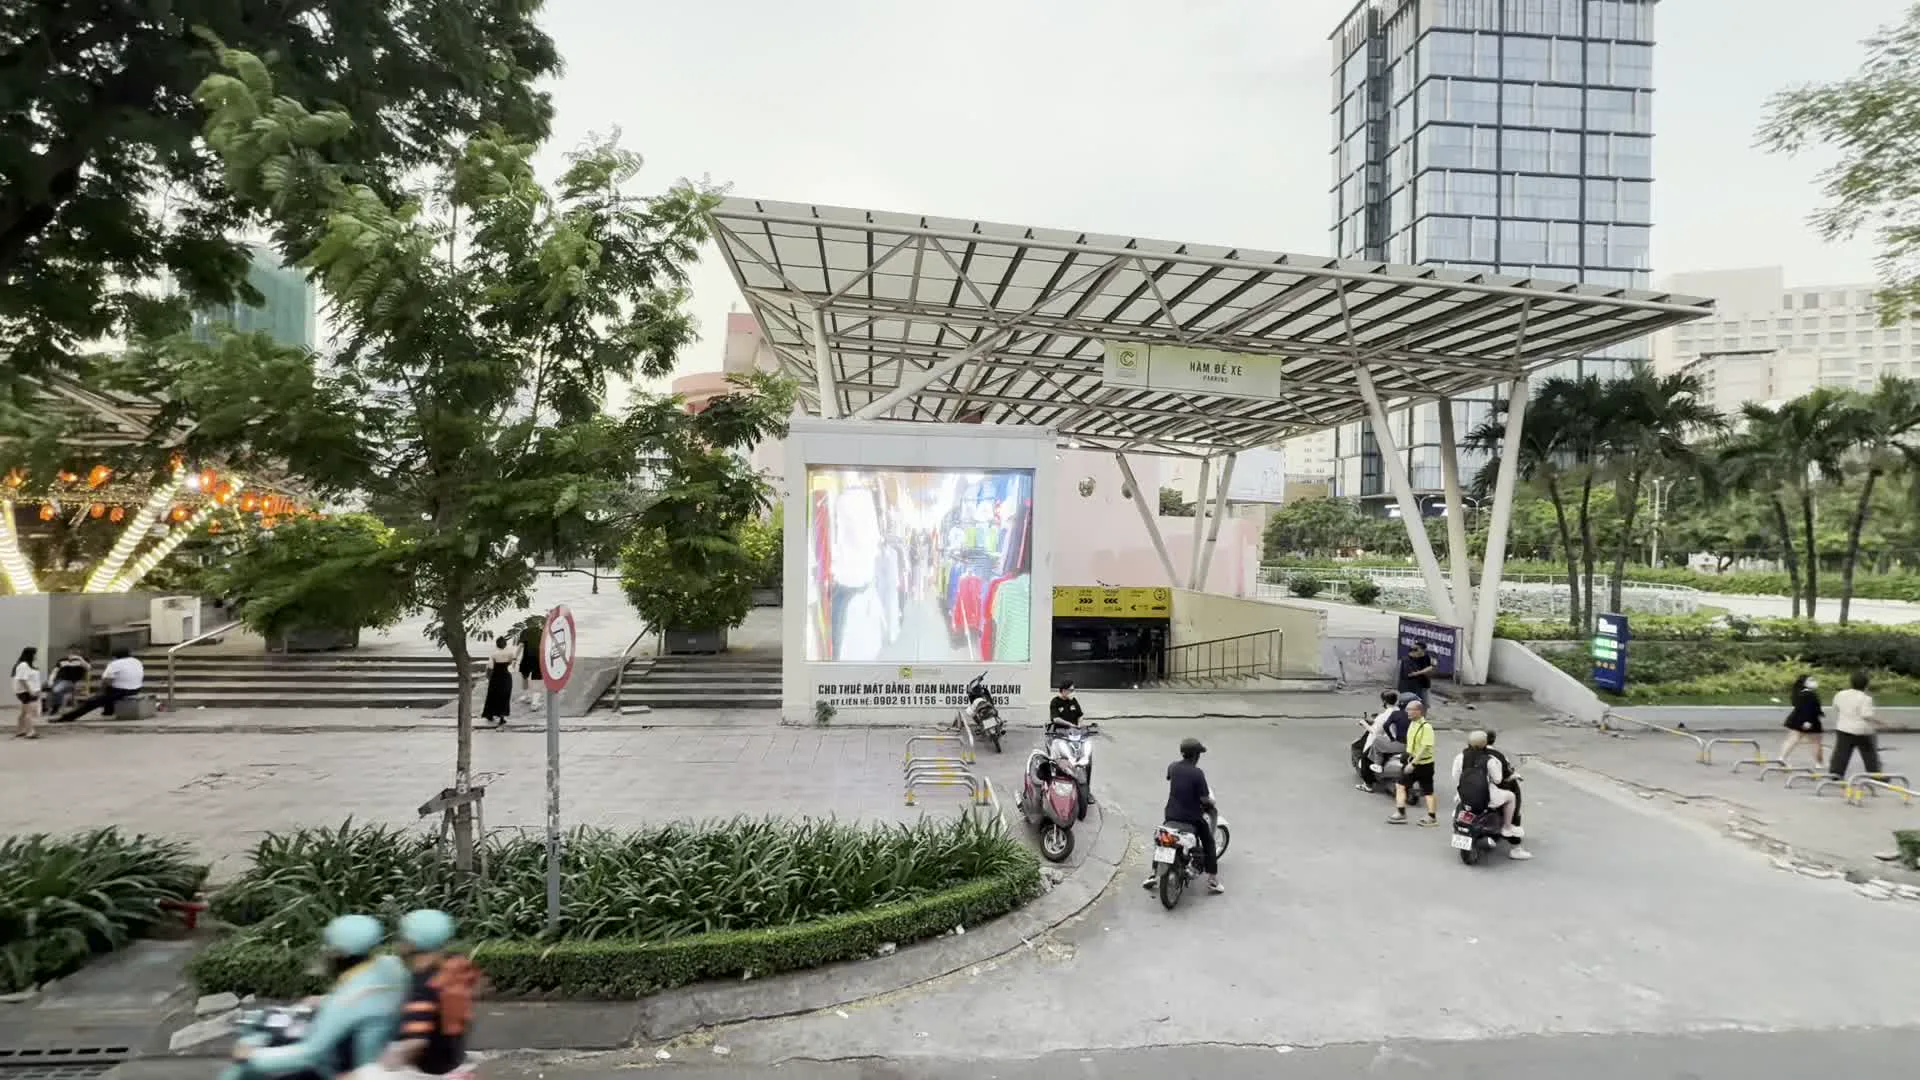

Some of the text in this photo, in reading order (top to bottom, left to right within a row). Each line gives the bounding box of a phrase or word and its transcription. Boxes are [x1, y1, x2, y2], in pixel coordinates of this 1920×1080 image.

[1231, 365, 1243, 376] XE
[818, 684, 837, 695] CHO
[839, 682, 862, 695] THUÊ
[915, 684, 937, 694] GIAN
[873, 696, 898, 705] 0902
[900, 696, 937, 705] 911156
